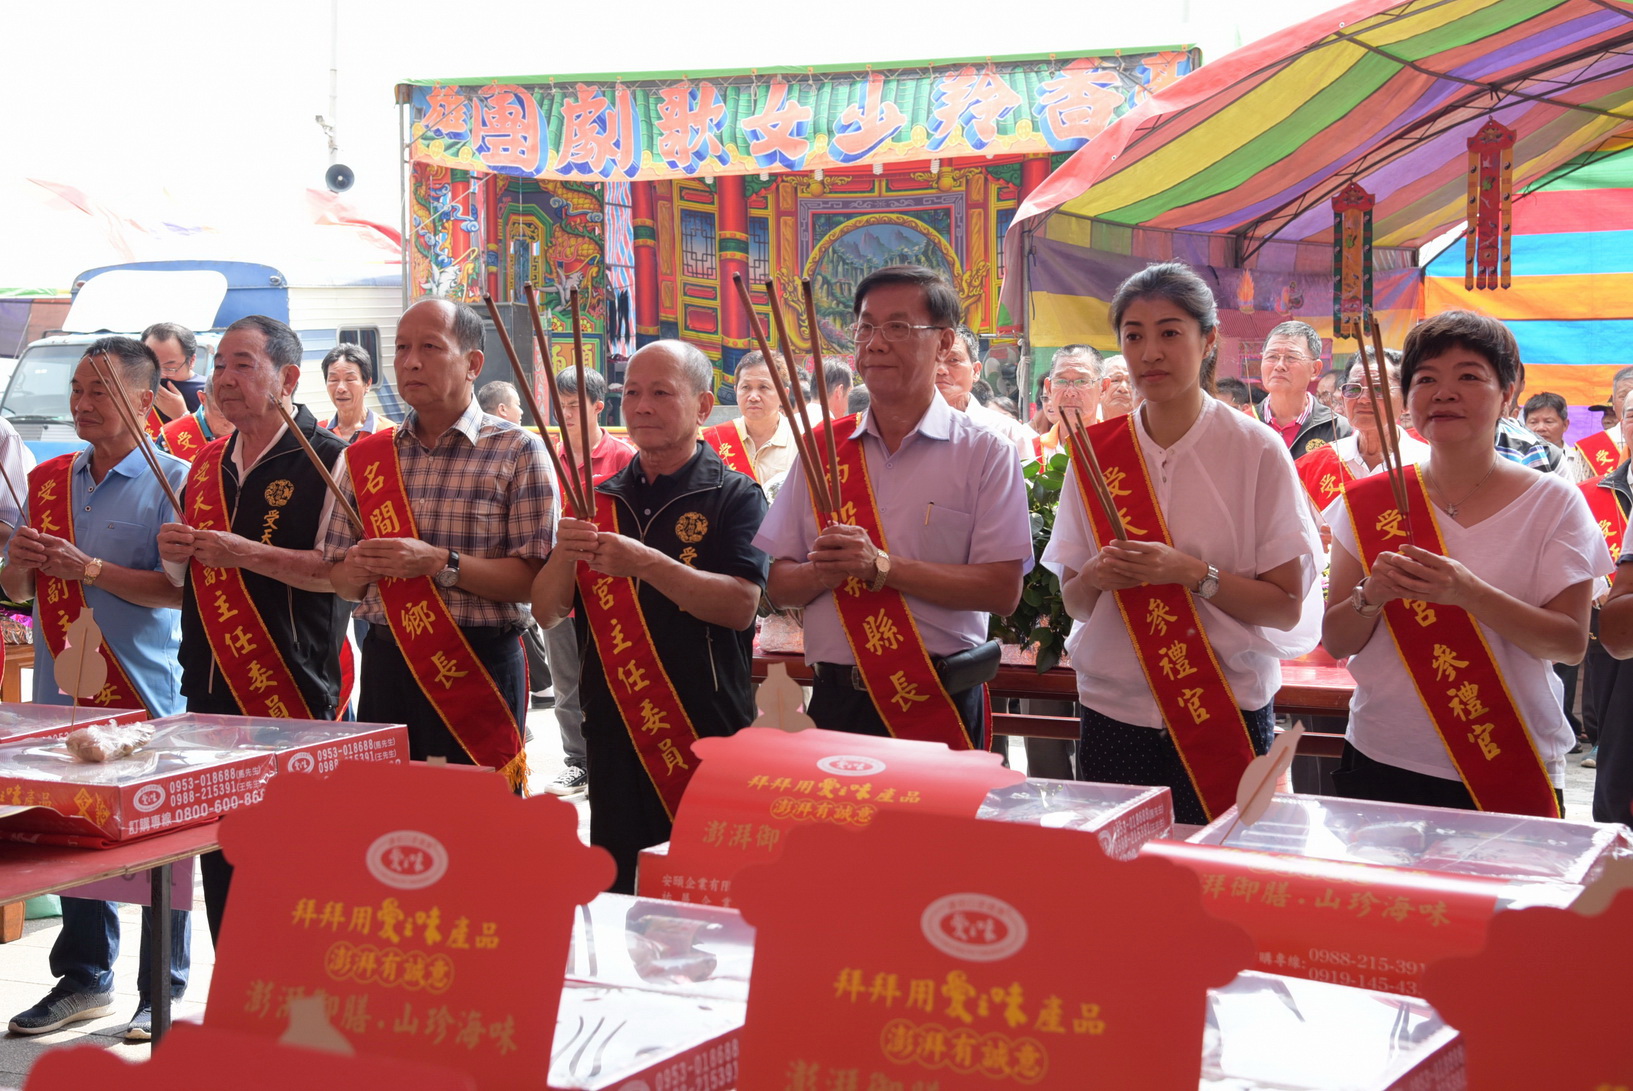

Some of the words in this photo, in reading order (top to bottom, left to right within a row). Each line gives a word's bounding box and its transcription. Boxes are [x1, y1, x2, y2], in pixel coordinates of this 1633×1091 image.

[361, 461, 468, 690] 名間鄉長
[589, 568, 689, 776] 宮主任委員
[1376, 510, 1501, 761] 受宮參禮官
